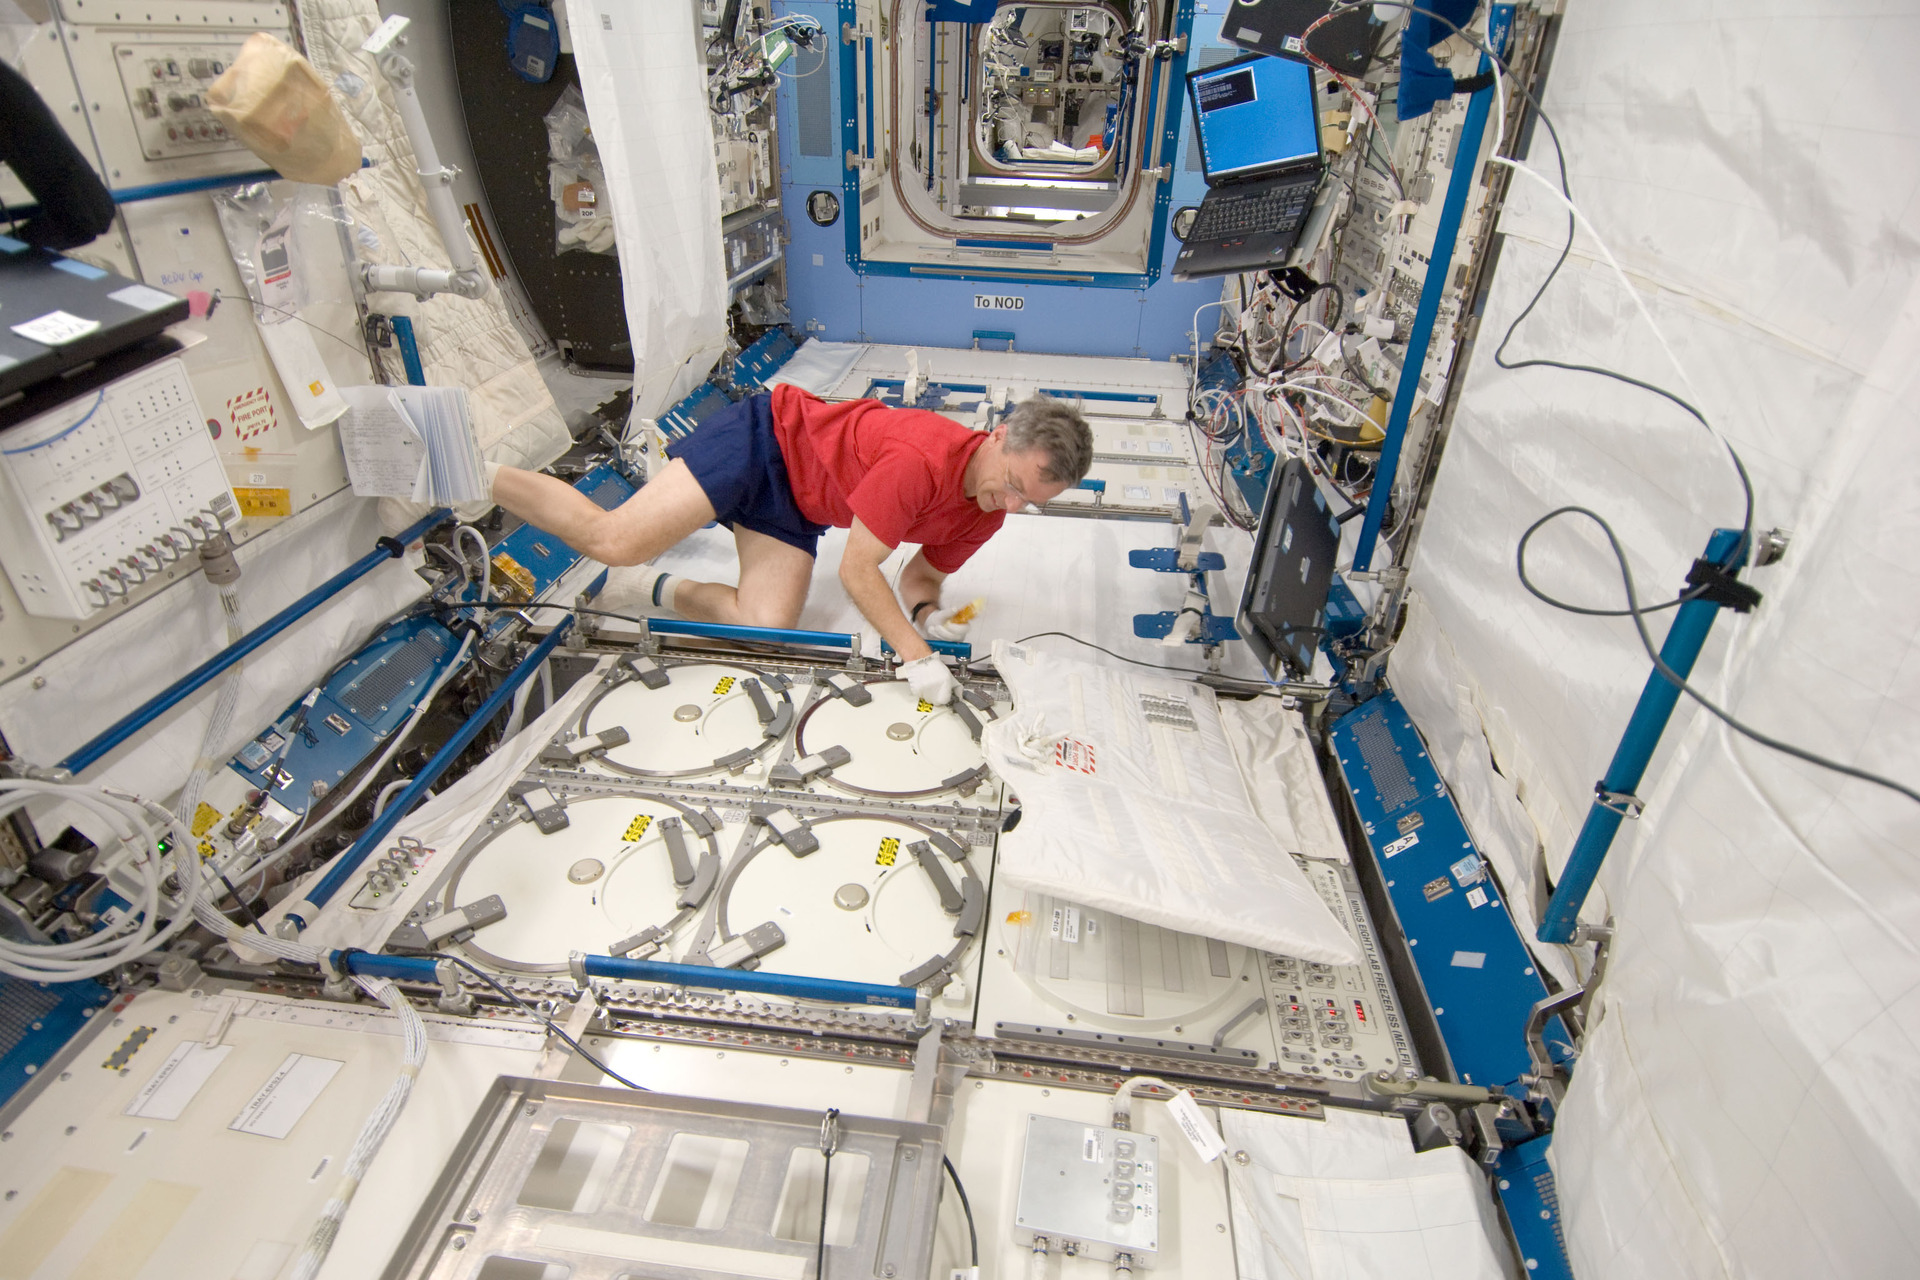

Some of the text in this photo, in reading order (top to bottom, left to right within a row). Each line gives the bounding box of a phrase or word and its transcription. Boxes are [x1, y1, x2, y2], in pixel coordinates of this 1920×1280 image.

[975, 295, 1024, 310] To NOD
[237, 405, 268, 423] FIRE PORT
[253, 474, 264, 483] 27P
[1350, 899, 1412, 1066] MINUS EIGHTY LAB FREEZER ISS (MELFI)
[249, 1071, 286, 1110] TRAY-EPS2-4
